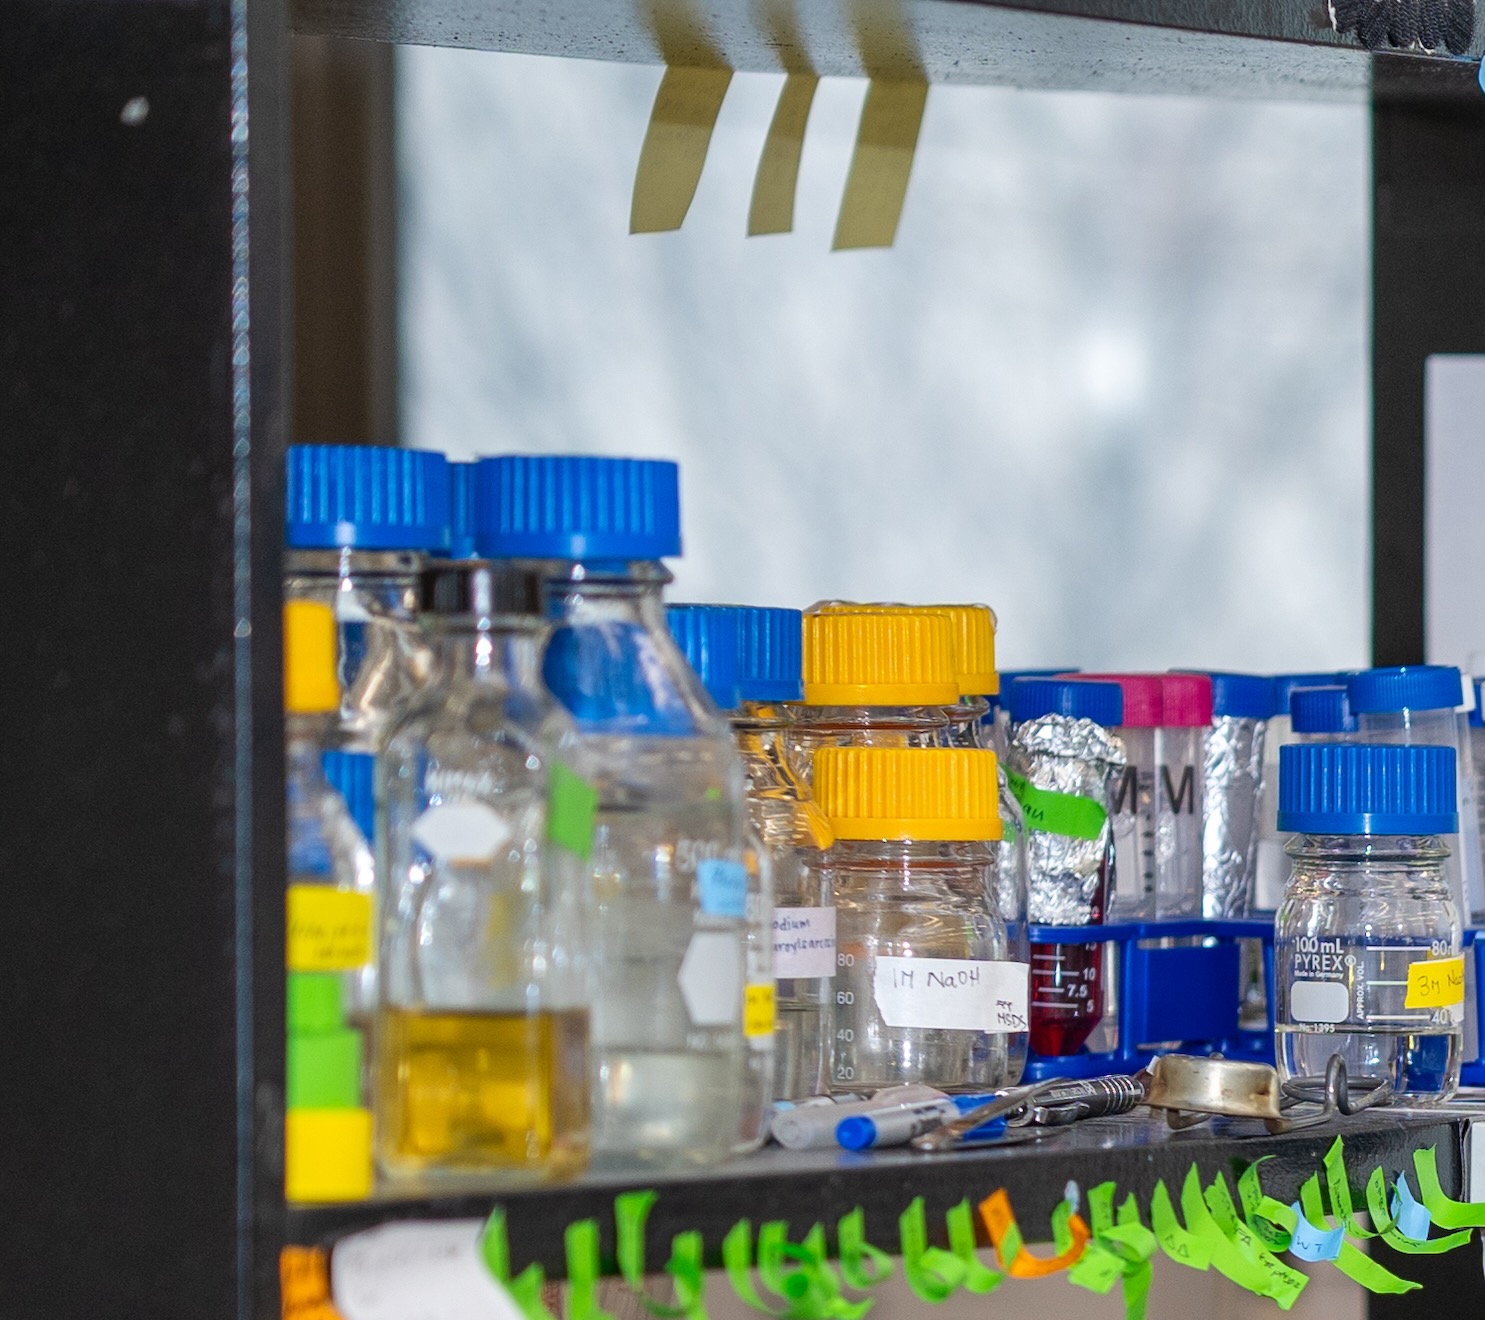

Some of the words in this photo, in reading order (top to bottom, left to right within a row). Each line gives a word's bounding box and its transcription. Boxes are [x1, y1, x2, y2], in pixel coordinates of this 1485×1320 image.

[1294, 935, 1319, 953] 100
[1321, 937, 1345, 954] mL
[837, 953, 855, 967] 80
[927, 966, 981, 989] NaOH
[1082, 967, 1096, 981] 10
[1067, 982, 1088, 998] 7.5
[837, 991, 855, 1005] 60
[836, 1029, 855, 1043] 40
[837, 1066, 855, 1080] 20
